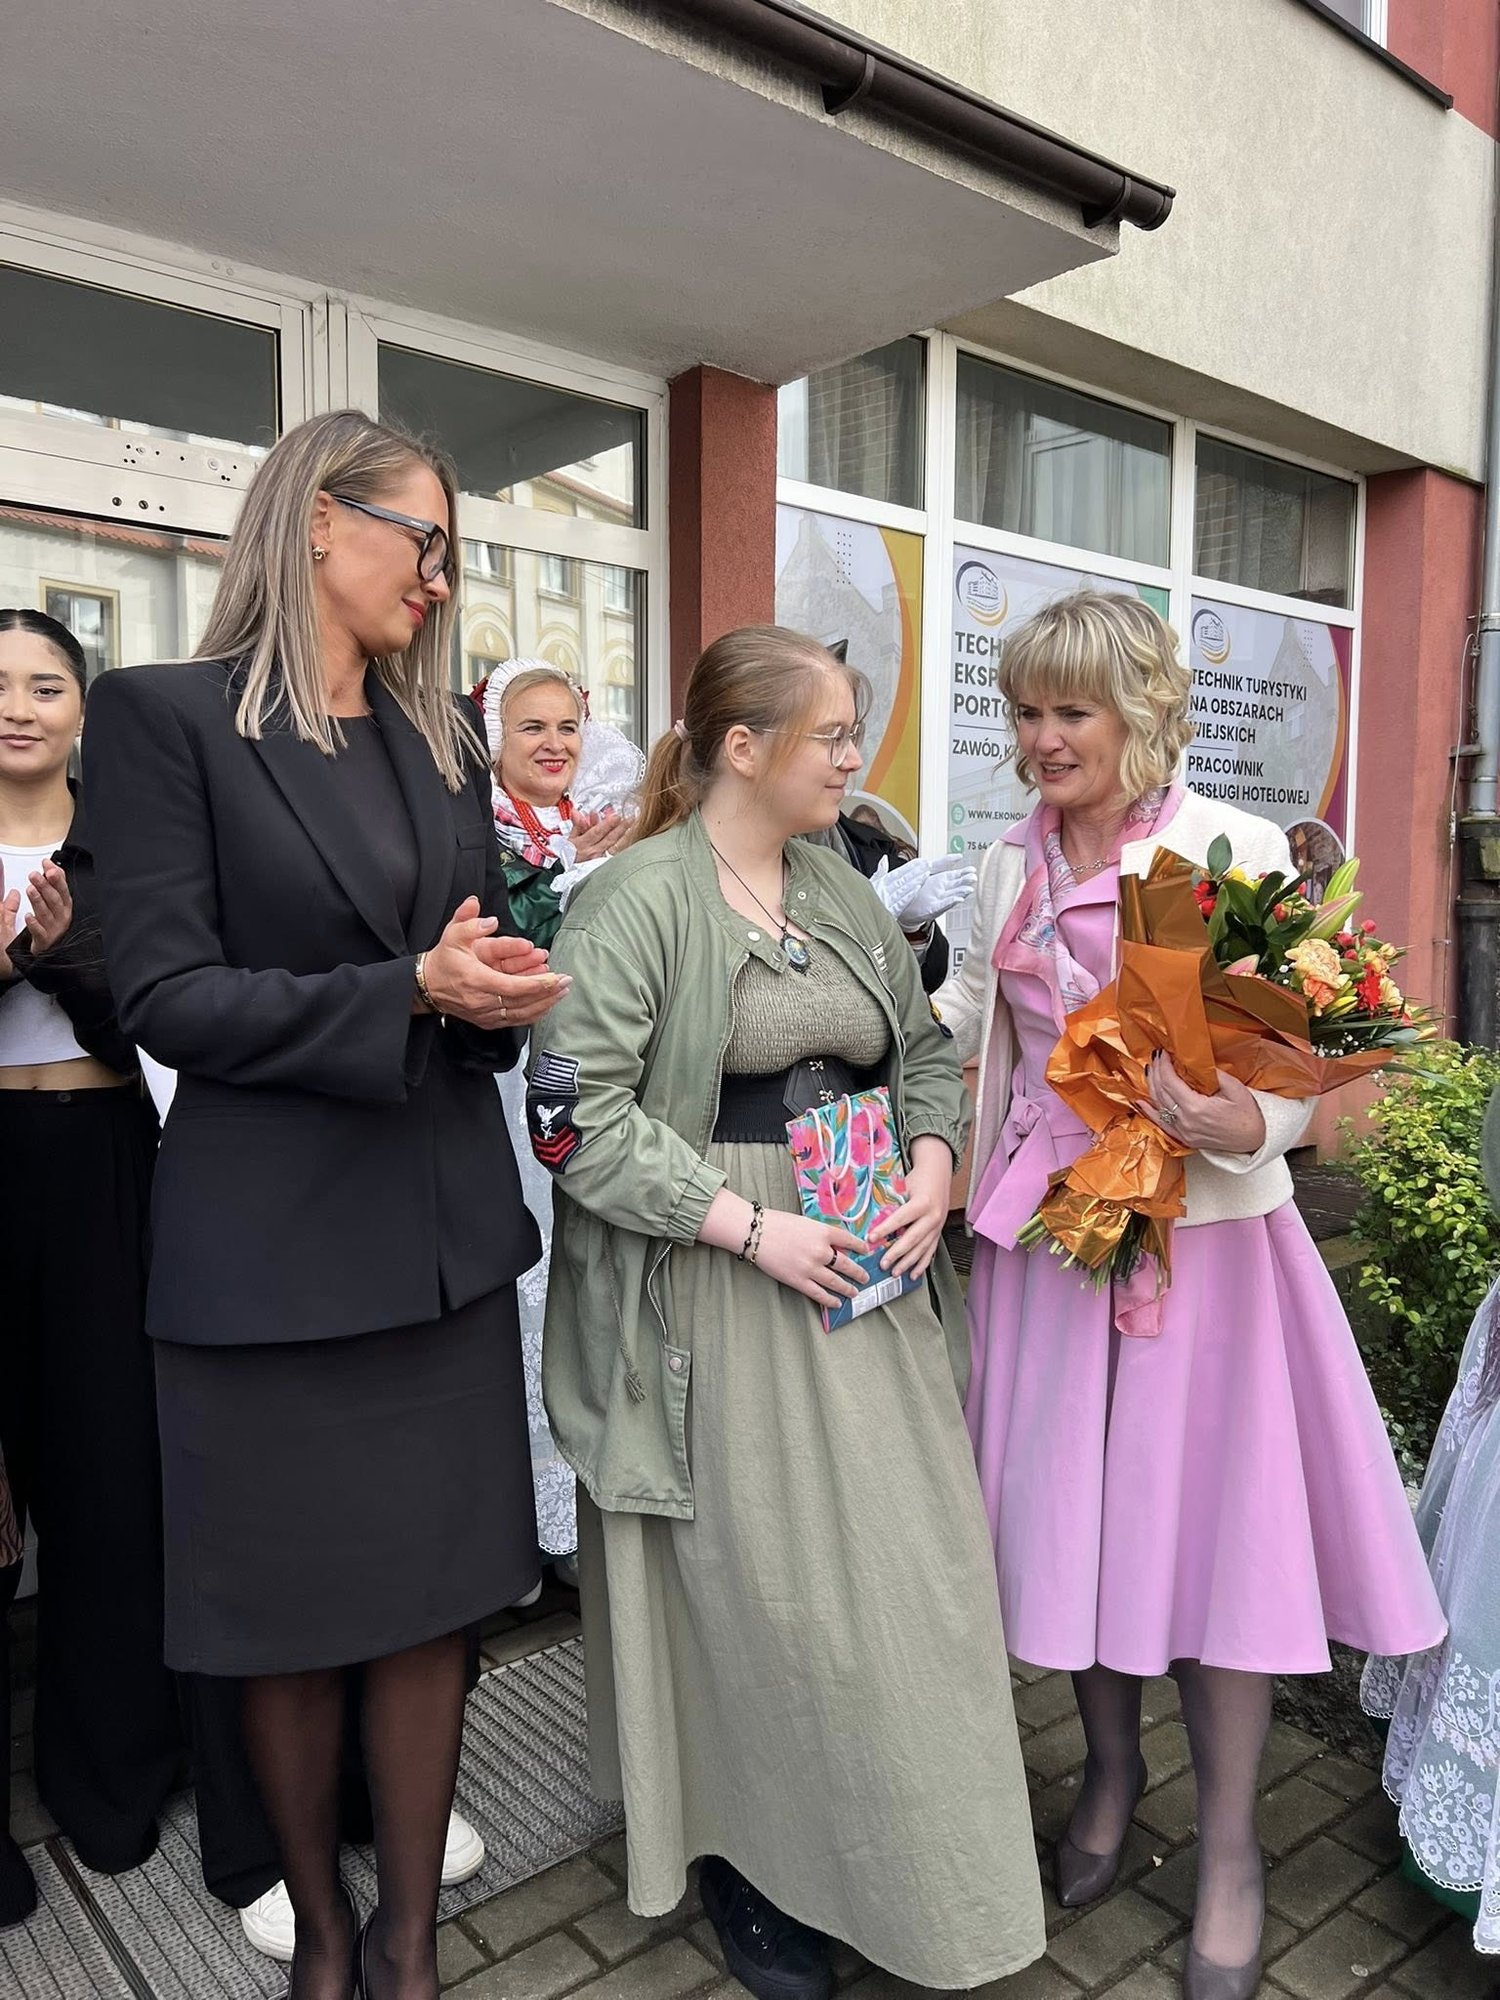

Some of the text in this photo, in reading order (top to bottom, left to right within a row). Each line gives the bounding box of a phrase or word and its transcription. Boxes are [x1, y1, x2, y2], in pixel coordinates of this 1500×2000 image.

[955, 631, 1002, 658] TECH
[954, 662, 998, 687] EKSP
[1192, 669, 1307, 701] TECHNIK TURYSTYKI
[1190, 695, 1284, 722] NA OBSZARACH
[952, 737, 1002, 760] ZAWÓD,
[1188, 755, 1264, 777] PRACOWNIK
[1187, 781, 1310, 805] OBSŁUGI HOTELOWEJ
[968, 810, 1027, 821] WWW.EKONOM
